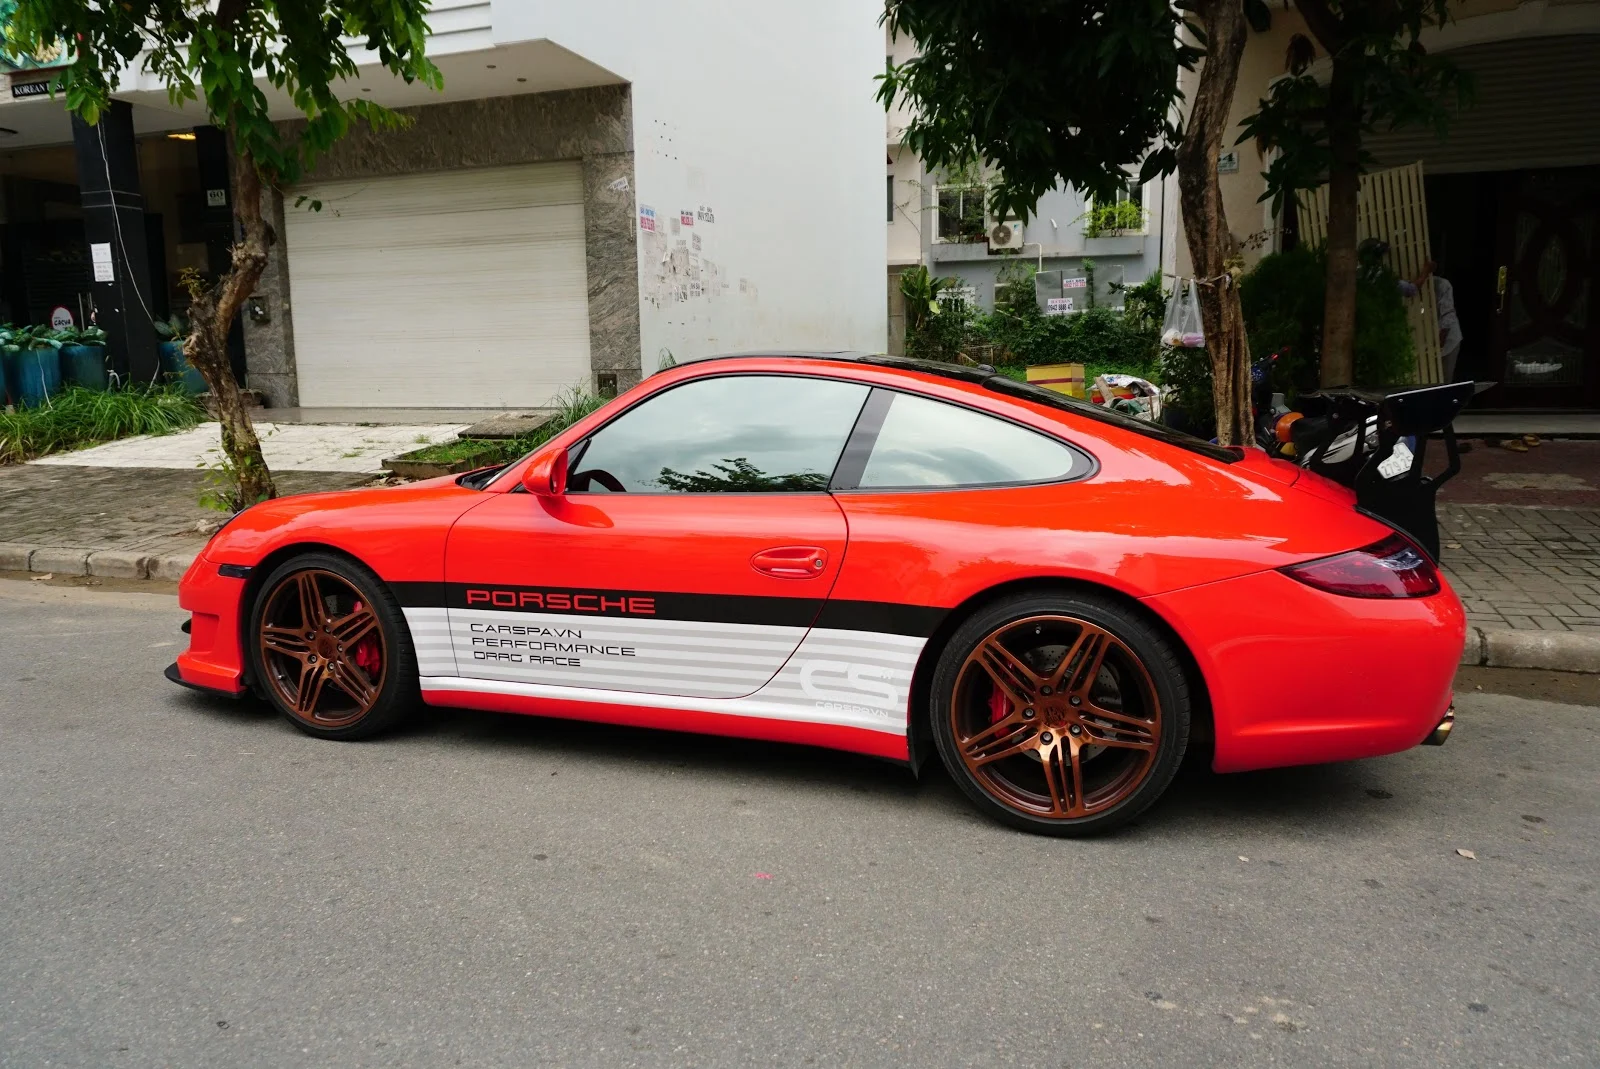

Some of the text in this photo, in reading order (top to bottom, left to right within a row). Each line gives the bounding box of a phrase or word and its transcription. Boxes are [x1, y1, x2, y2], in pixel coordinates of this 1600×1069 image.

[14, 83, 46, 95] KOREAN
[209, 189, 224, 198] 60
[466, 589, 656, 614] PORSCHE
[472, 638, 636, 657] PERFORMANCE
[473, 651, 581, 667] DRAG RACE
[800, 659, 899, 711] CS
